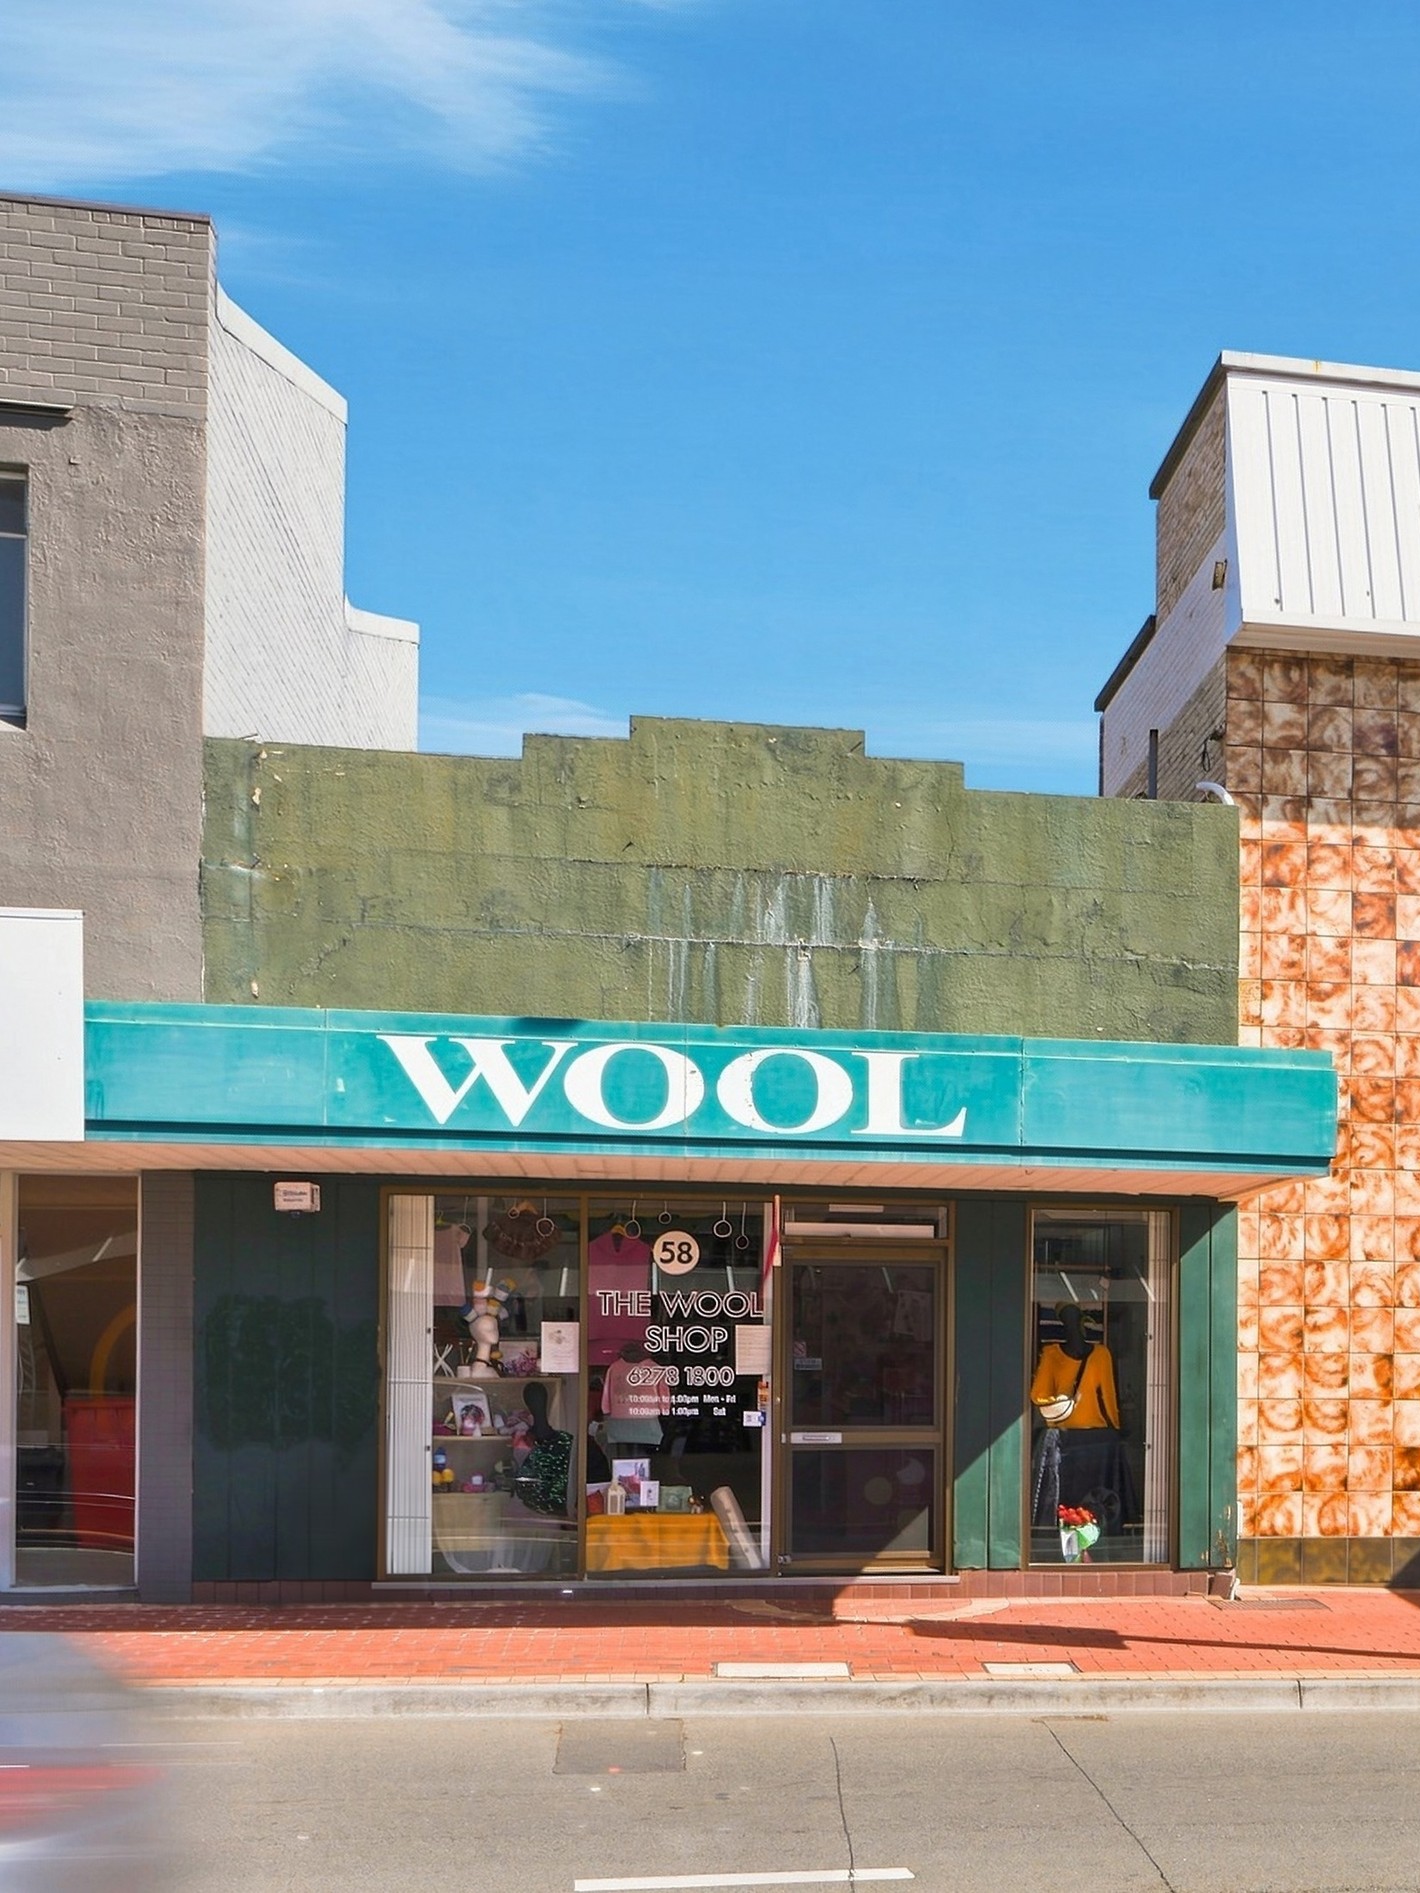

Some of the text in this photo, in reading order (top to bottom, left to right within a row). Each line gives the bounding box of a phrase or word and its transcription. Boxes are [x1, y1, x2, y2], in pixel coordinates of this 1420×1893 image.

[376, 1035, 967, 1137] WOOL
[659, 1241, 693, 1265] 58
[597, 1290, 764, 1318] THE WOOL
[644, 1325, 729, 1353] SHOP
[627, 1365, 735, 1387] 6278 1800
[661, 1407, 670, 1416] to
[712, 1406, 727, 1416] Sat
[702, 1394, 720, 1404] Mon
[725, 1394, 737, 1404] Fri
